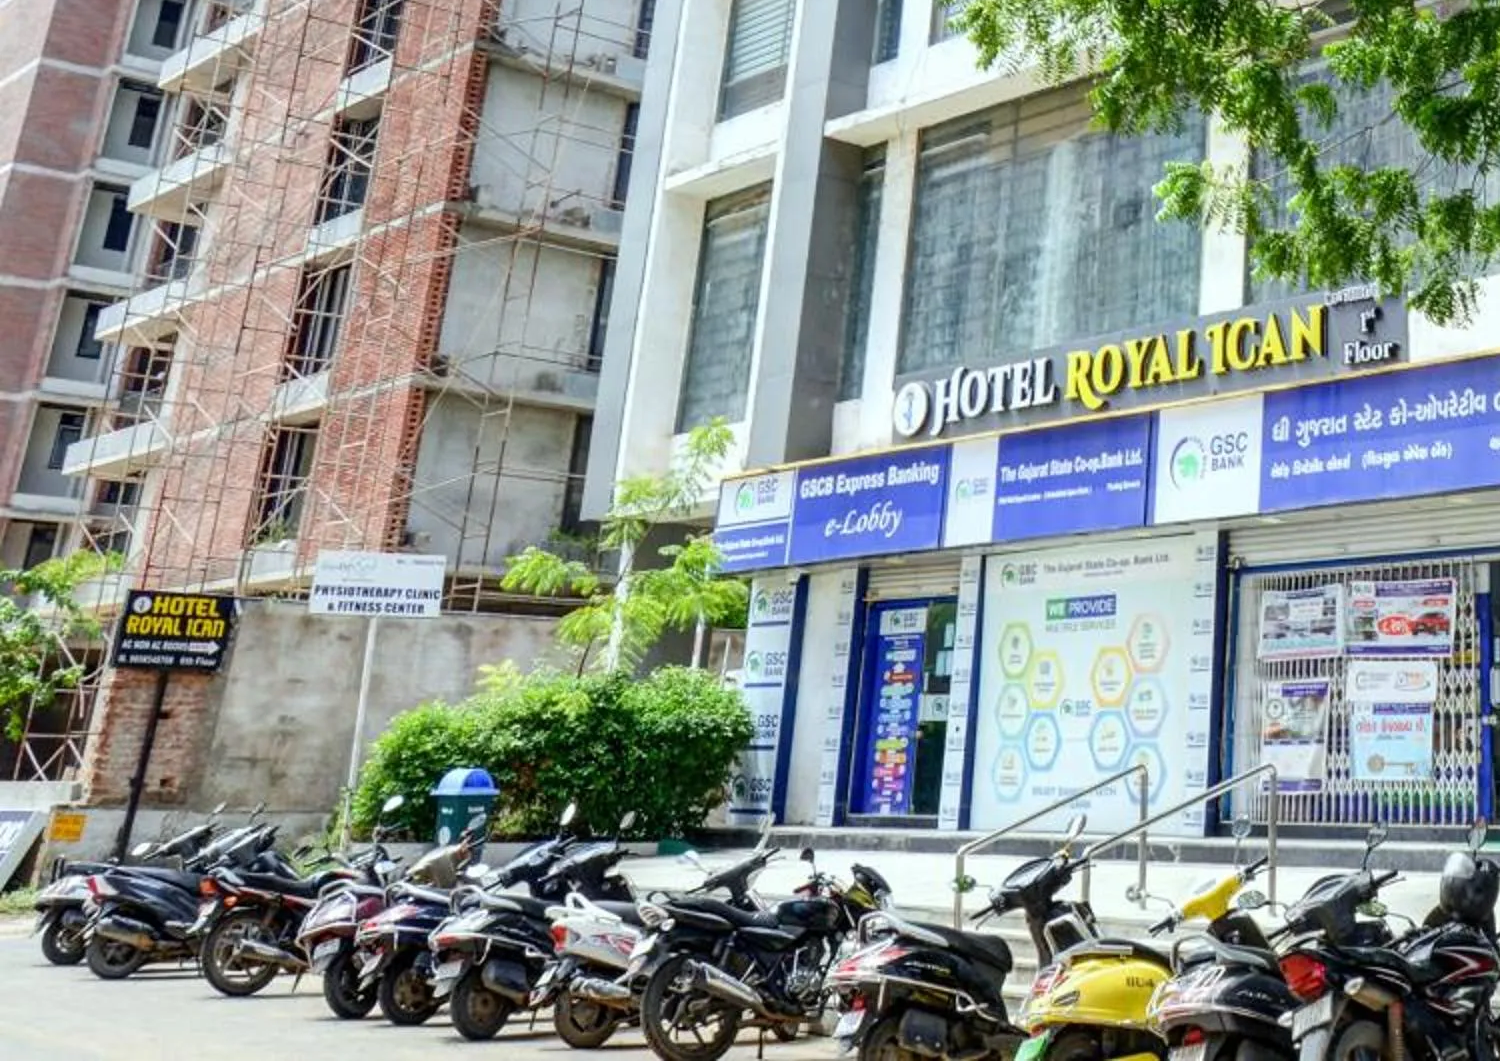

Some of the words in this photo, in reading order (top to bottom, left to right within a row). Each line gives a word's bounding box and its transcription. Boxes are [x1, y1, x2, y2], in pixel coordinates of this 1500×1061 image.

[1343, 340, 1393, 365] Floor
[930, 355, 1055, 435] HOTEL
[1065, 327, 1202, 409] ROYAL
[1205, 302, 1325, 375] ICAN
[1295, 414, 1348, 448] ગુજરાત
[1210, 432, 1248, 455] GSC
[1001, 466, 1016, 483] The
[1017, 461, 1049, 484] Gujarat
[1050, 458, 1073, 476] State
[1101, 449, 1123, 470] Bank
[1125, 447, 1143, 466] Ltd.
[1210, 453, 1245, 473] BANK
[757, 478, 780, 494] GSC
[800, 475, 834, 500] GSCB
[836, 471, 886, 498] Express
[887, 461, 940, 486] Banking
[824, 499, 903, 539] e-Lobby
[314, 584, 403, 599] PHYSIOTHERAPY
[405, 588, 441, 600] CLINIC
[771, 590, 793, 605] GSC
[153, 596, 220, 618] HOTEL
[337, 600, 382, 613] FITNESS
[384, 602, 425, 614] CENTER
[1048, 602, 1065, 617] WE
[1069, 597, 1116, 614] PROVIDE
[126, 615, 181, 636] ROYAL
[185, 618, 225, 638] ICAN
[764, 650, 787, 665] GSC
[757, 713, 779, 728] GSC
[751, 777, 772, 792] GSC
